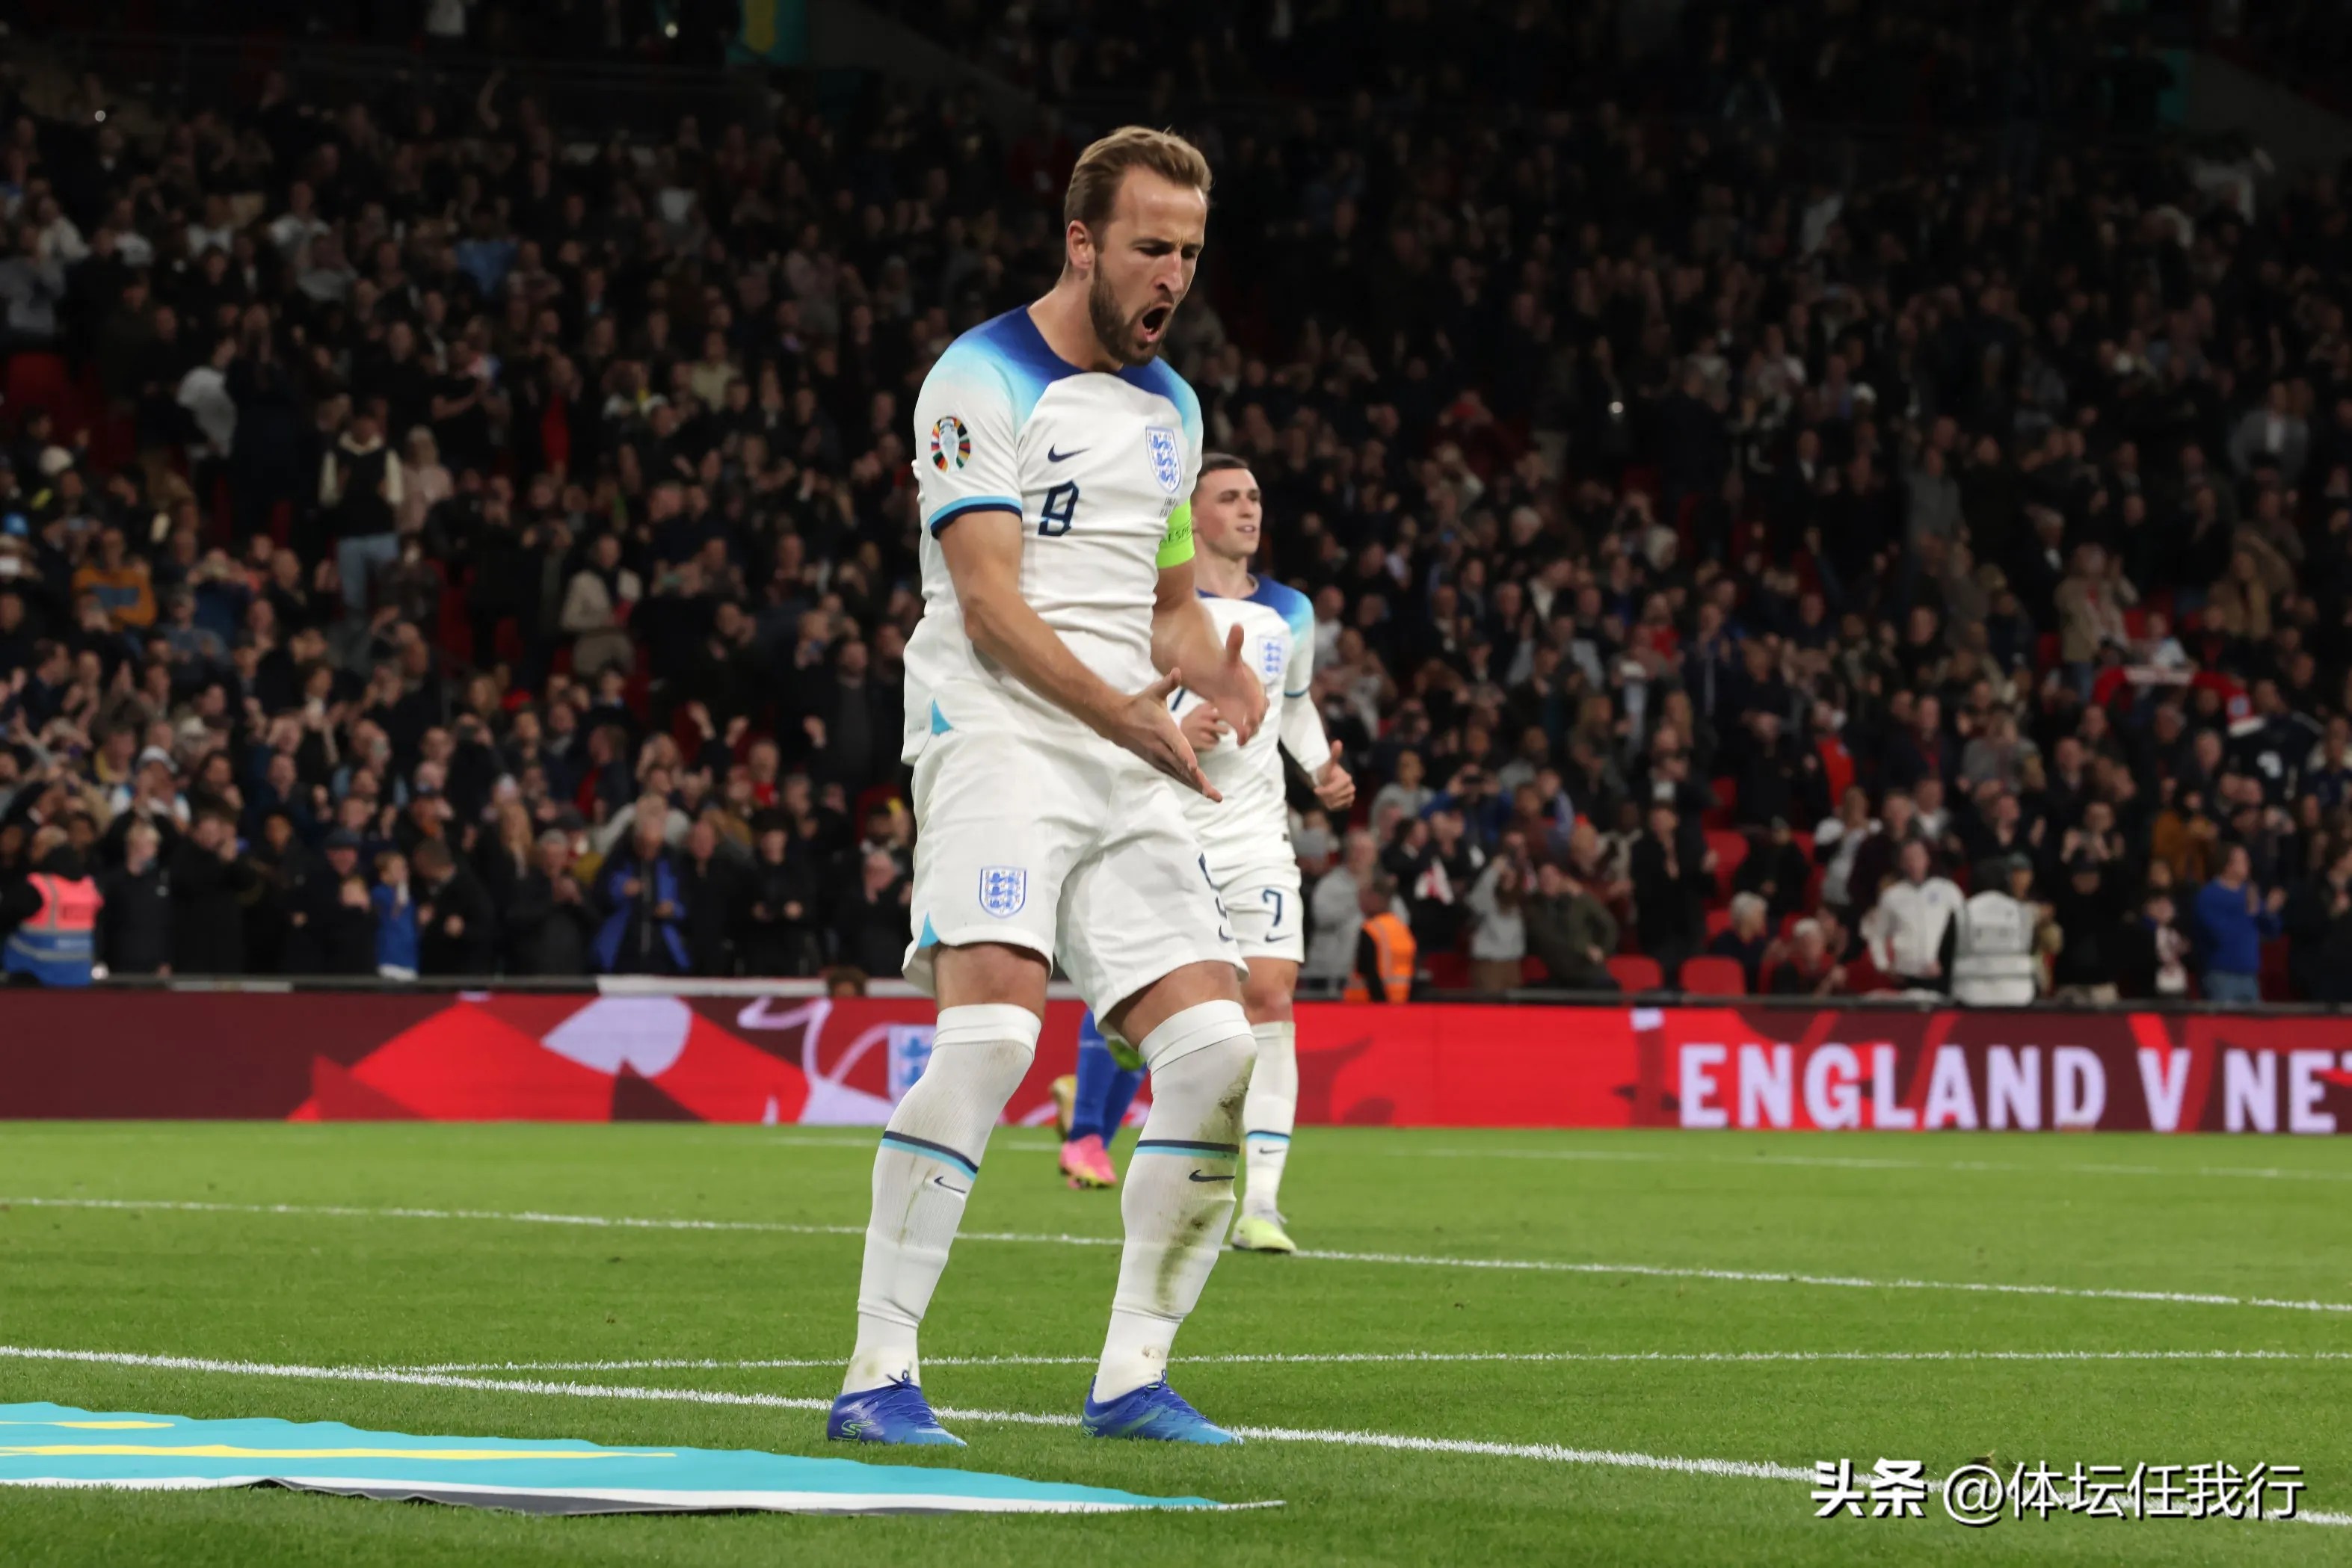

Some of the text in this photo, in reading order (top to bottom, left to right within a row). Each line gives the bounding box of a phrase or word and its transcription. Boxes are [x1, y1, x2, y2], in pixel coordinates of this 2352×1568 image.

[1263, 888, 1282, 927] 7
[1679, 1043, 2352, 1133] ENGLAND V NE
